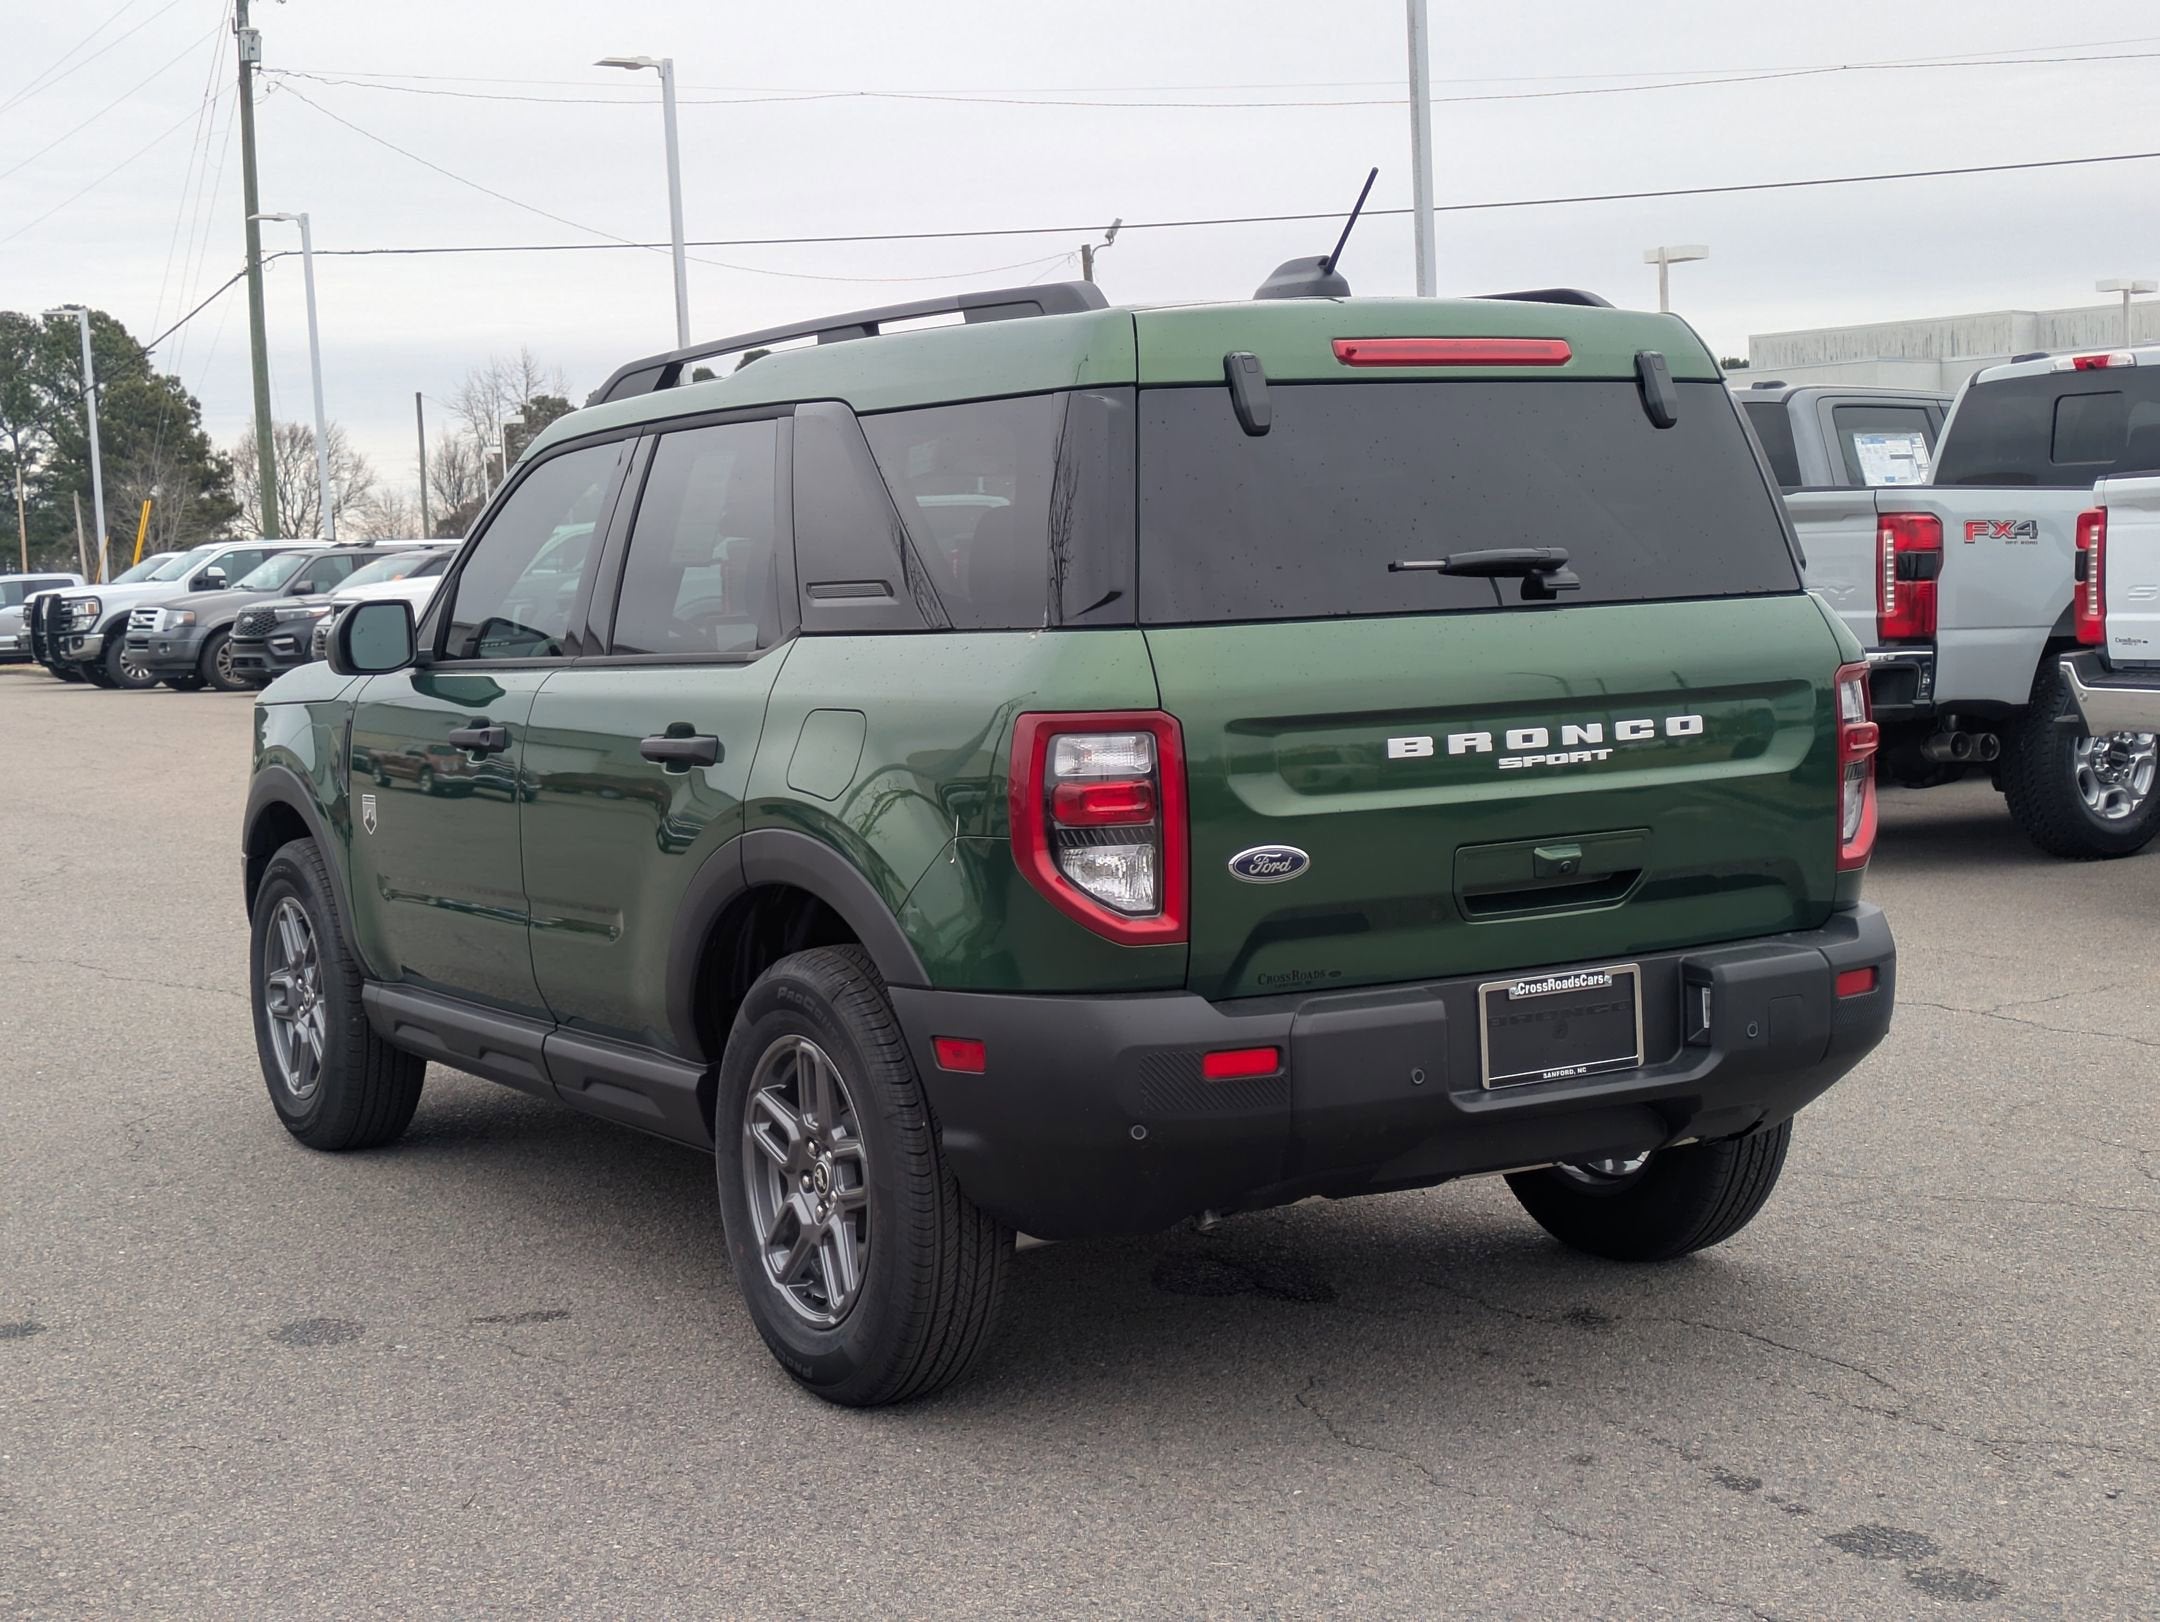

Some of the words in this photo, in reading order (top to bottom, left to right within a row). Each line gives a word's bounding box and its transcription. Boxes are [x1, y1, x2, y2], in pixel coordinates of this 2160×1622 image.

[1964, 519, 2039, 544] FX4
[1387, 714, 1704, 759] BRONCO
[1498, 748, 1613, 770] SPORT
[1249, 853, 1293, 875] Ford
[1517, 973, 1604, 995] CrossRoadsCars
[1543, 1068, 1576, 1079] SANFORD,
